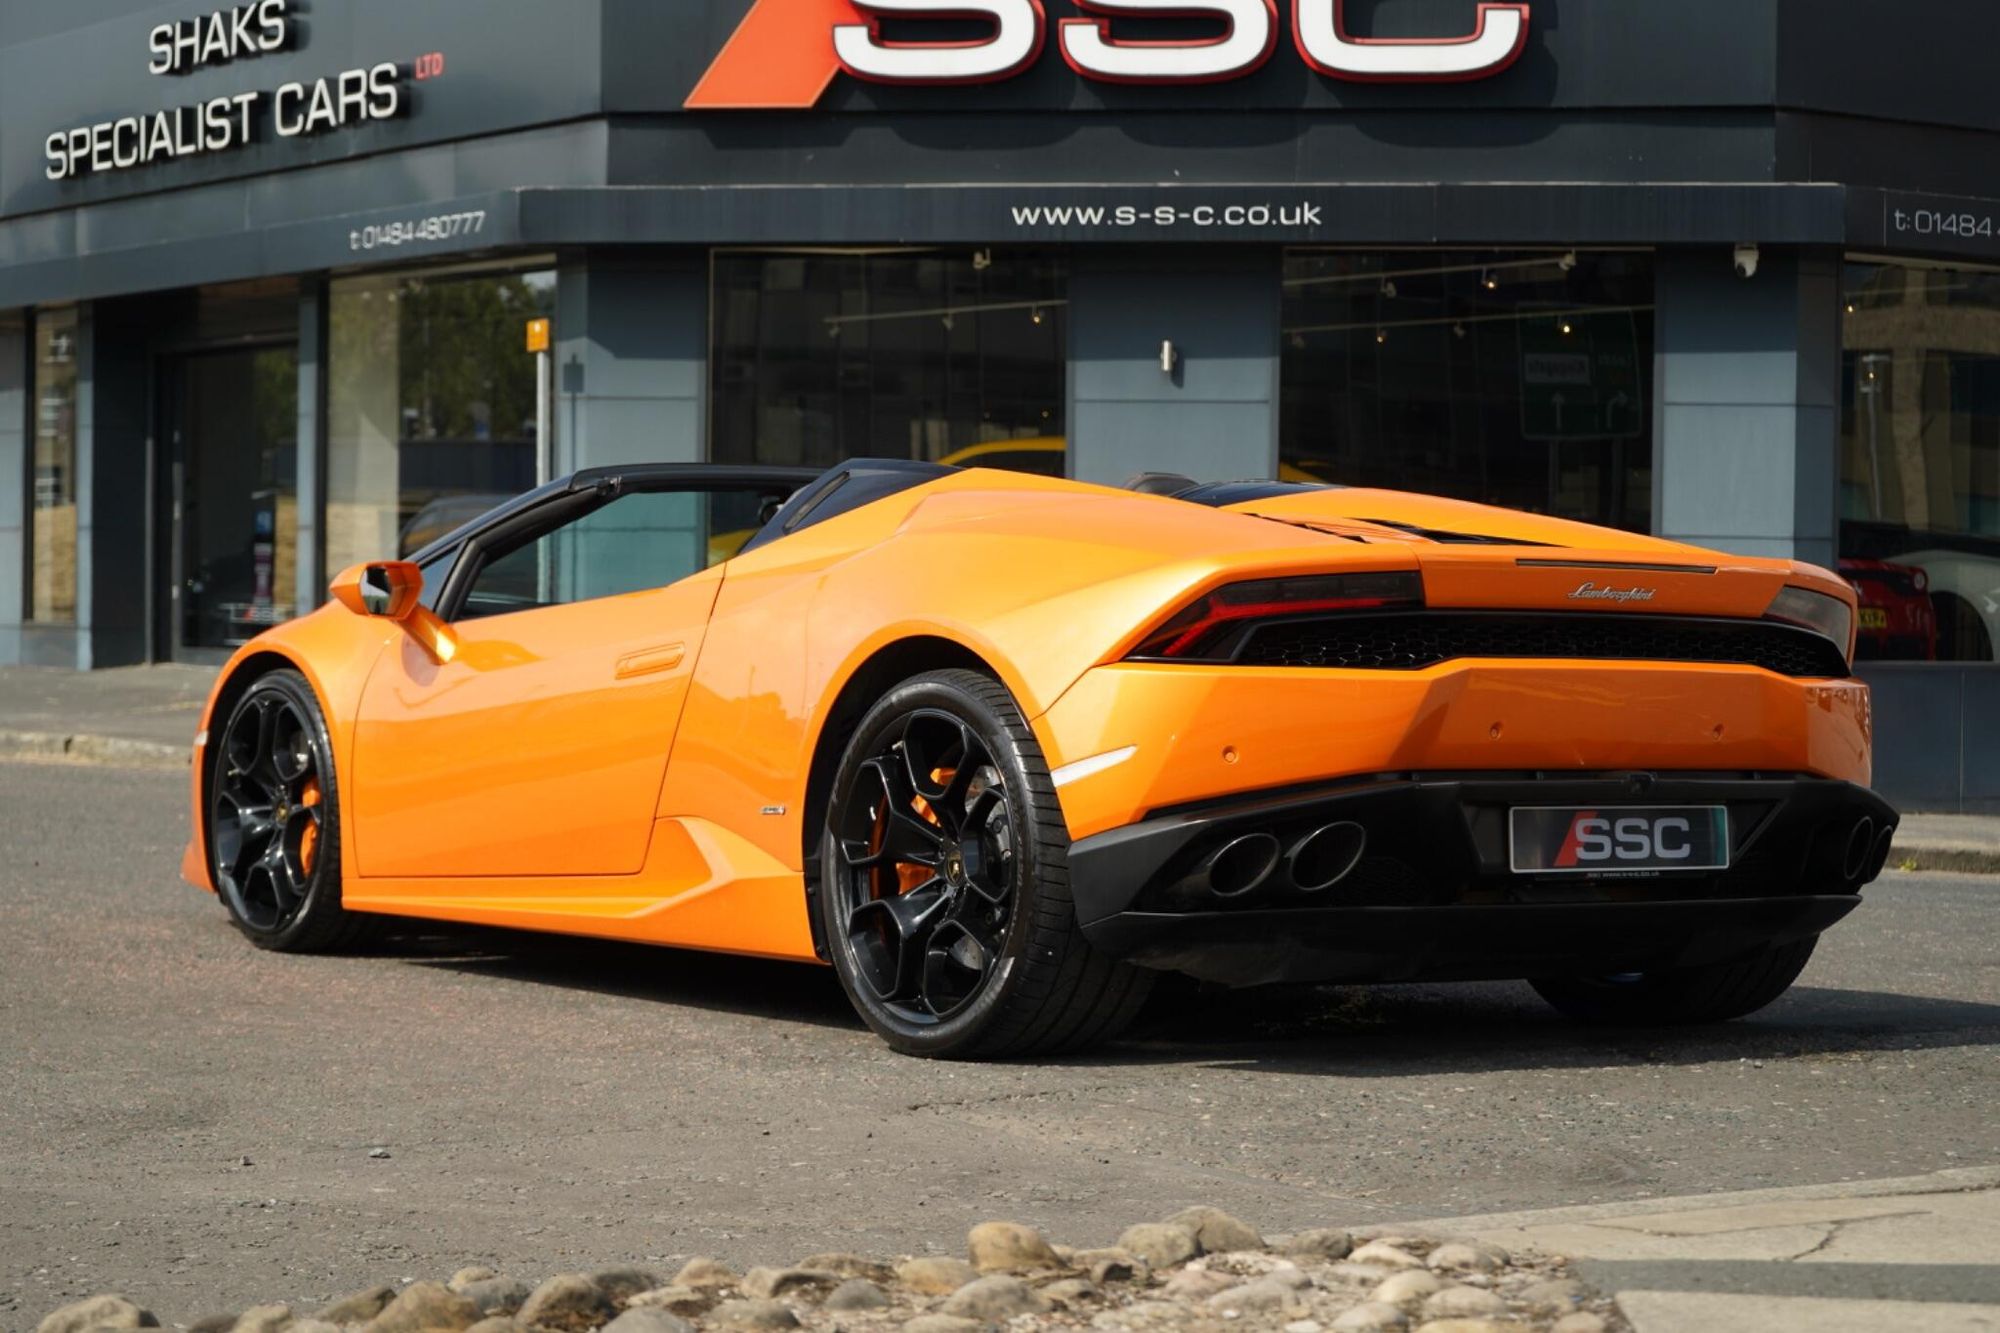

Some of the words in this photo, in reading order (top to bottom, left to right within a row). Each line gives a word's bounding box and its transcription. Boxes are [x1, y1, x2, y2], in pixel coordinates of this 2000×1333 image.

[148, 0, 286, 75] SHAKS
[45, 91, 259, 181] SPECIALIST
[274, 62, 399, 137] CARS
[415, 52, 444, 80] LTD
[1011, 201, 1323, 226] www.s-s-c.co.uk
[1567, 582, 1657, 604] Lamborghini
[1575, 817, 1691, 860] SSC
